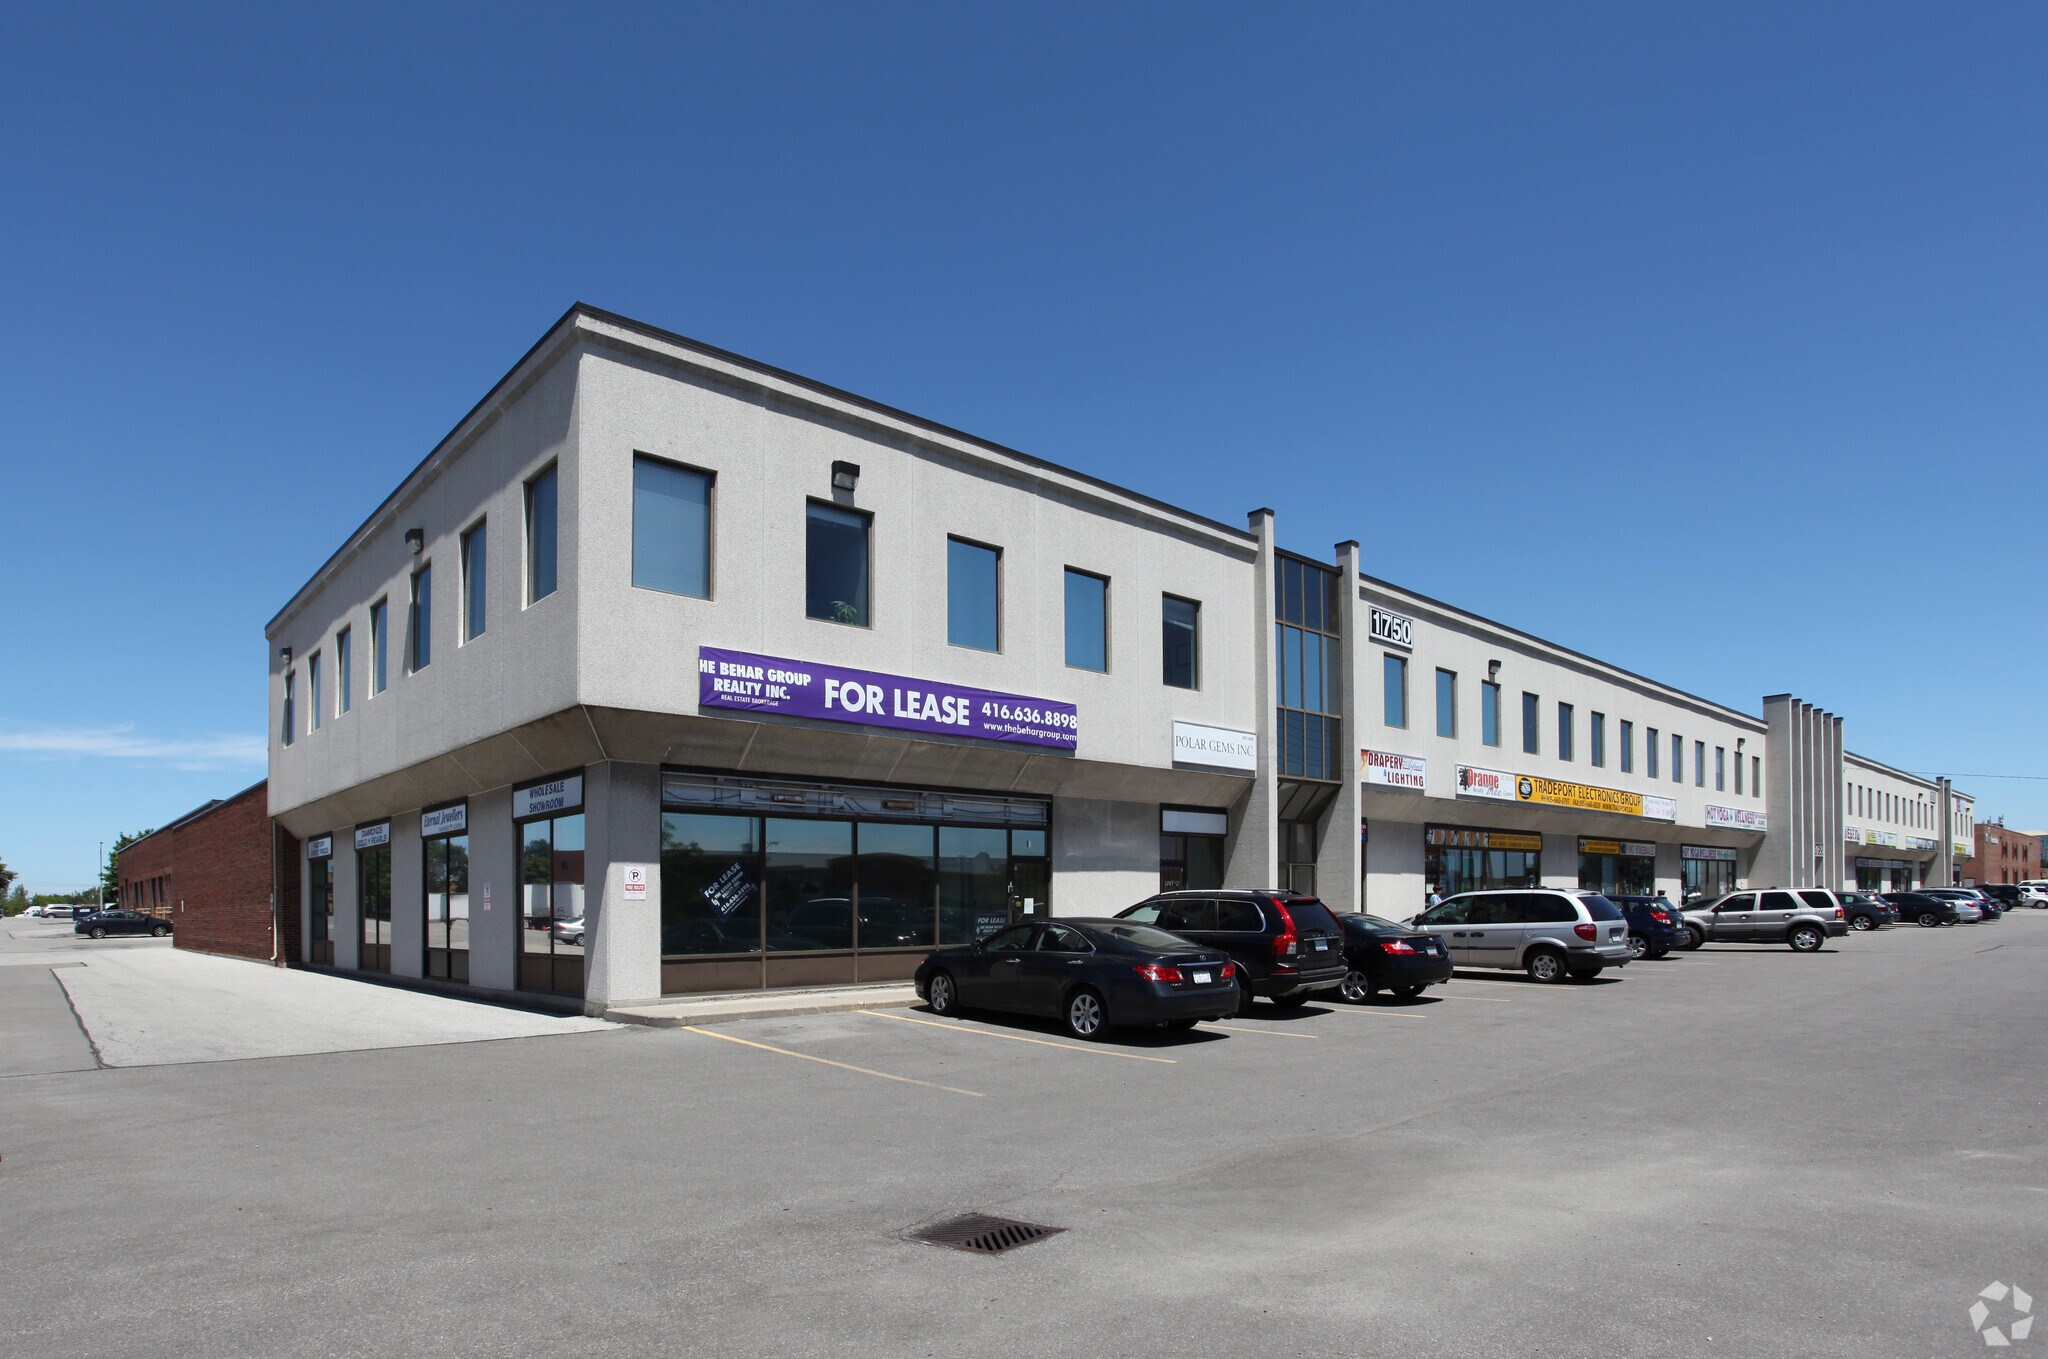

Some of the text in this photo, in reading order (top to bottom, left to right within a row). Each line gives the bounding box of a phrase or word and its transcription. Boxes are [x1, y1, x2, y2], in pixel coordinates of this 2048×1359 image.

[1373, 611, 1411, 643] 1750
[719, 662, 764, 680] BEHAR
[767, 669, 811, 686] GROUP
[713, 677, 790, 700] REALTY INC.
[824, 678, 970, 726] FOR LEASE
[981, 701, 1077, 729] 416.636.8898
[983, 722, 1077, 742] www.thebehargroup.com
[1175, 735, 1255, 757] POLAR GEMS INC.
[1368, 752, 1403, 770] DRAPERY
[1387, 771, 1424, 787] LIGHTING
[1467, 767, 1499, 790] Orange
[529, 782, 565, 799] WHOLESALE
[1533, 779, 1642, 807] TRADEPORT ELECTRONICS GROUP
[528, 797, 564, 813] SHOWROOM
[361, 826, 383, 838] DIAMONDS
[704, 862, 741, 898] FOR LEASE
